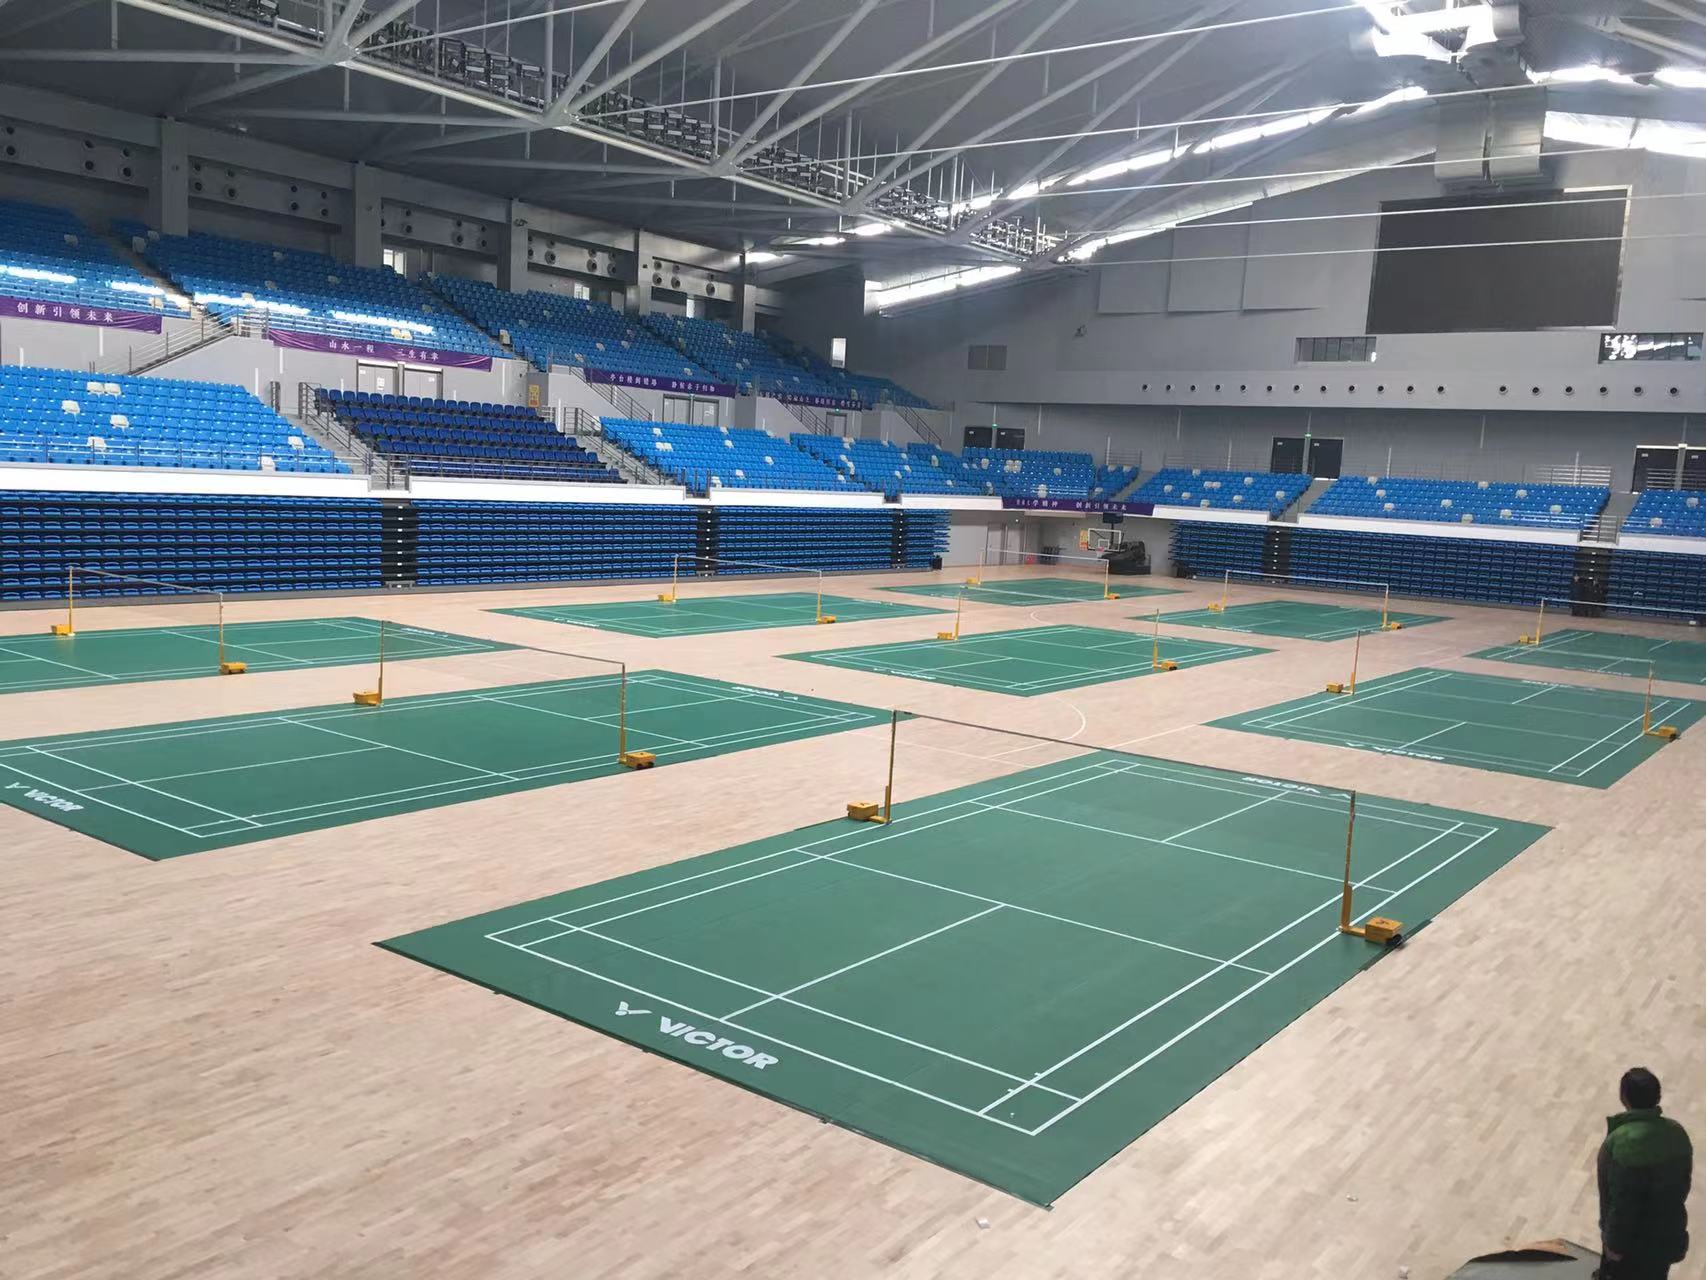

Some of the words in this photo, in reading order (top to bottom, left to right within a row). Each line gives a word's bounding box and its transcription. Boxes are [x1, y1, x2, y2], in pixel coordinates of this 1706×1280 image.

[17, 302, 114, 323] 创新引领未来
[659, 1015, 779, 1070] VICTOR
